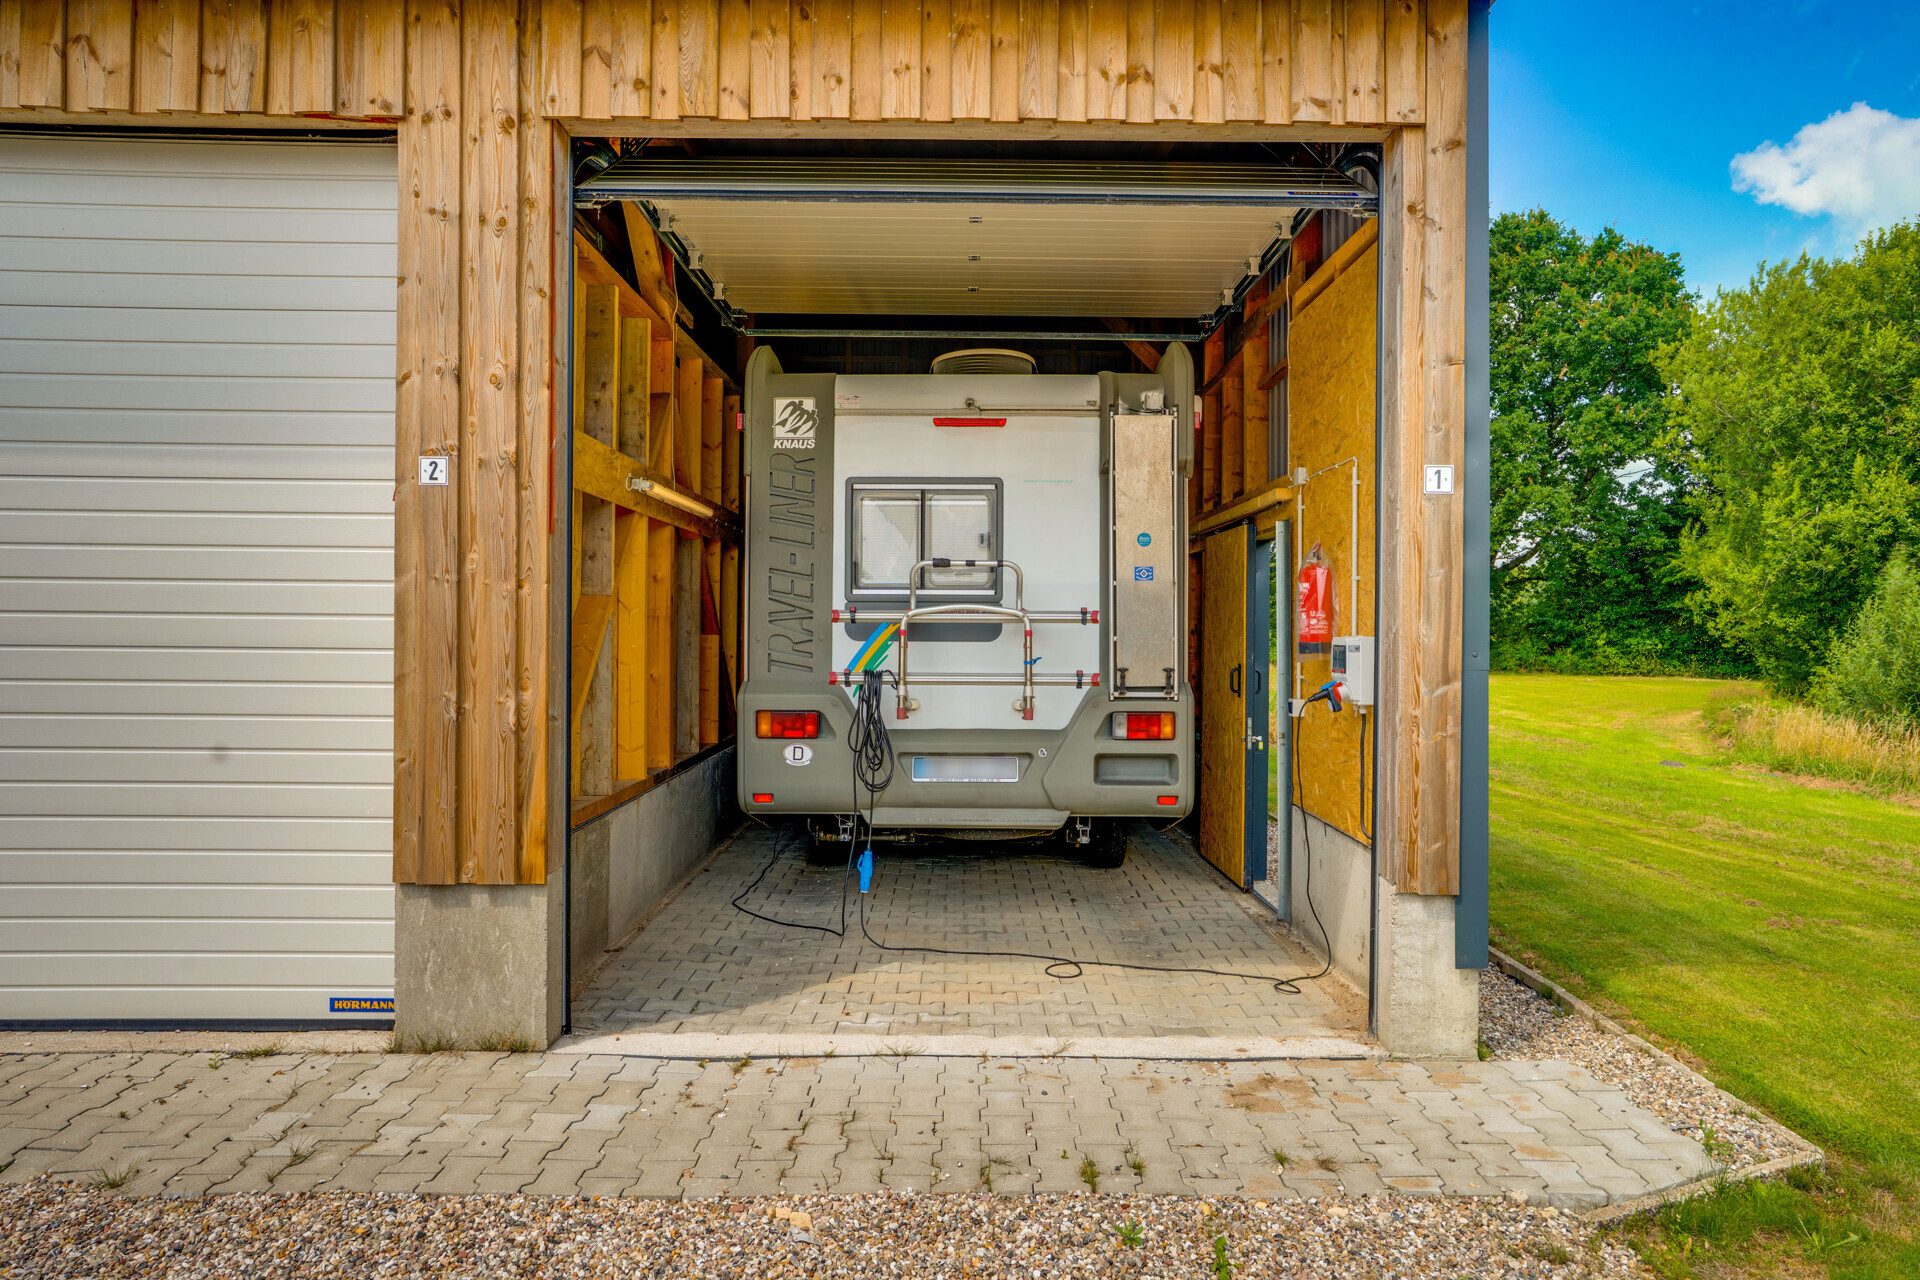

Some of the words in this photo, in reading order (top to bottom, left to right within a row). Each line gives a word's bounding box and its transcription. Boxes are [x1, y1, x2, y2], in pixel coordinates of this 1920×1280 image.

[773, 439, 816, 449] KNAUS
[429, 460, 439, 481] 2
[1434, 469, 1442, 490] 1
[768, 452, 815, 673] TRAVEL-LINER
[793, 746, 804, 761] D
